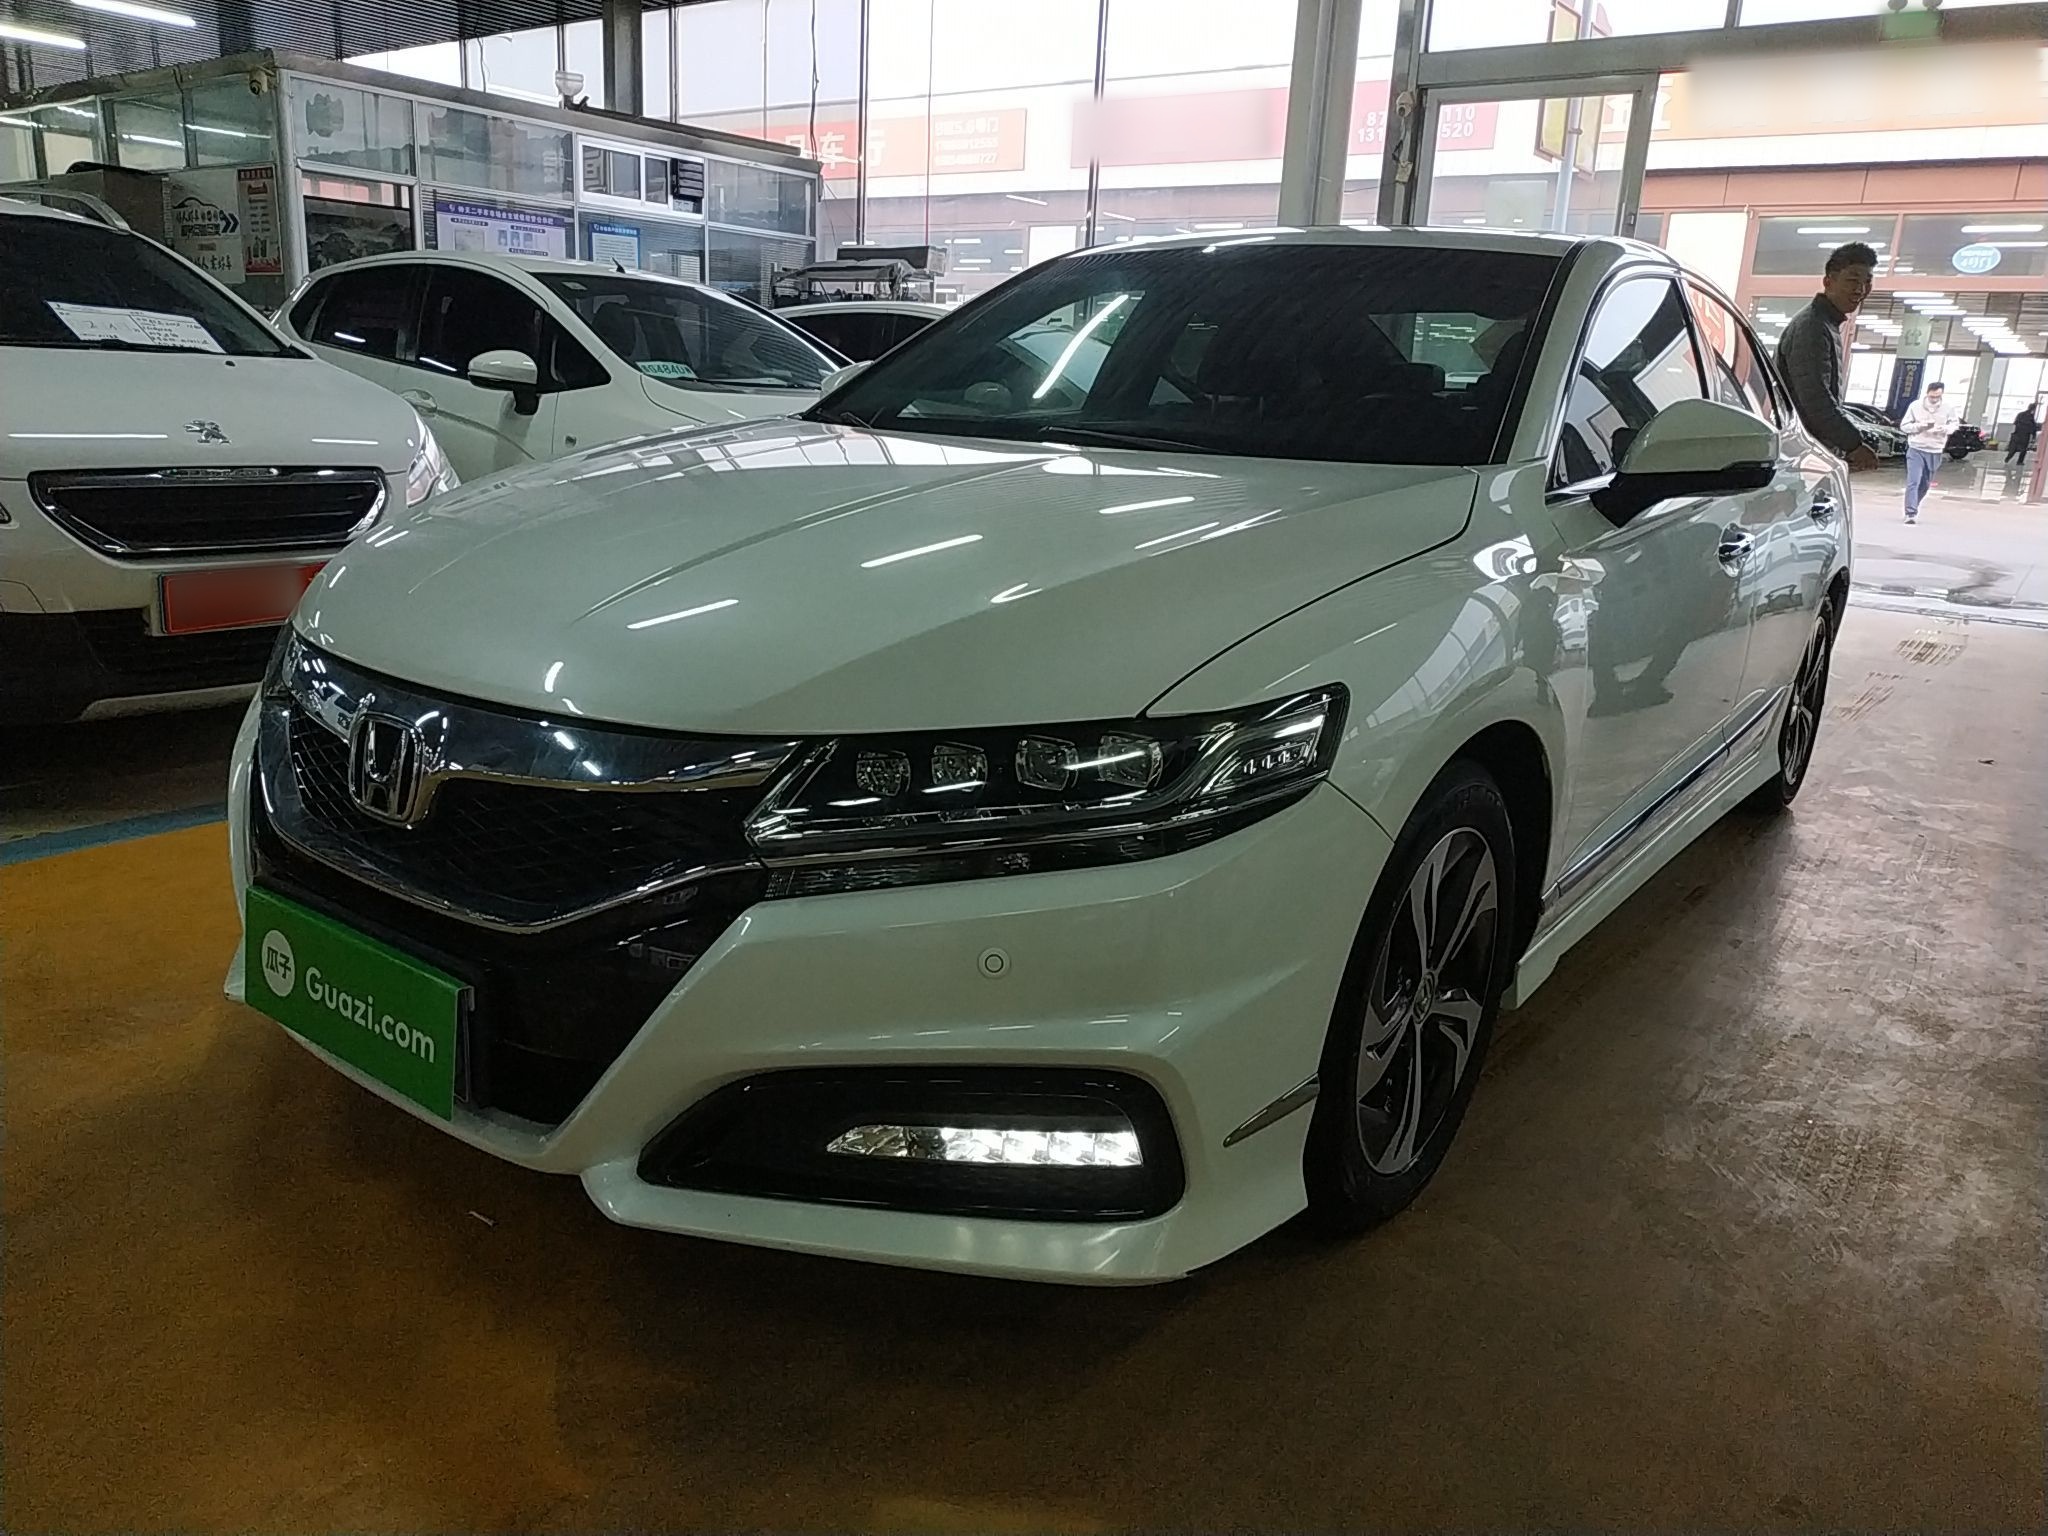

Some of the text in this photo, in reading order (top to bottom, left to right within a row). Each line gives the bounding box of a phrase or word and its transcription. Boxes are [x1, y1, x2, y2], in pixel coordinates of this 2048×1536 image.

[1441, 122, 1474, 138] 520
[266, 946, 435, 1064] 瓜子 Guazi.com
